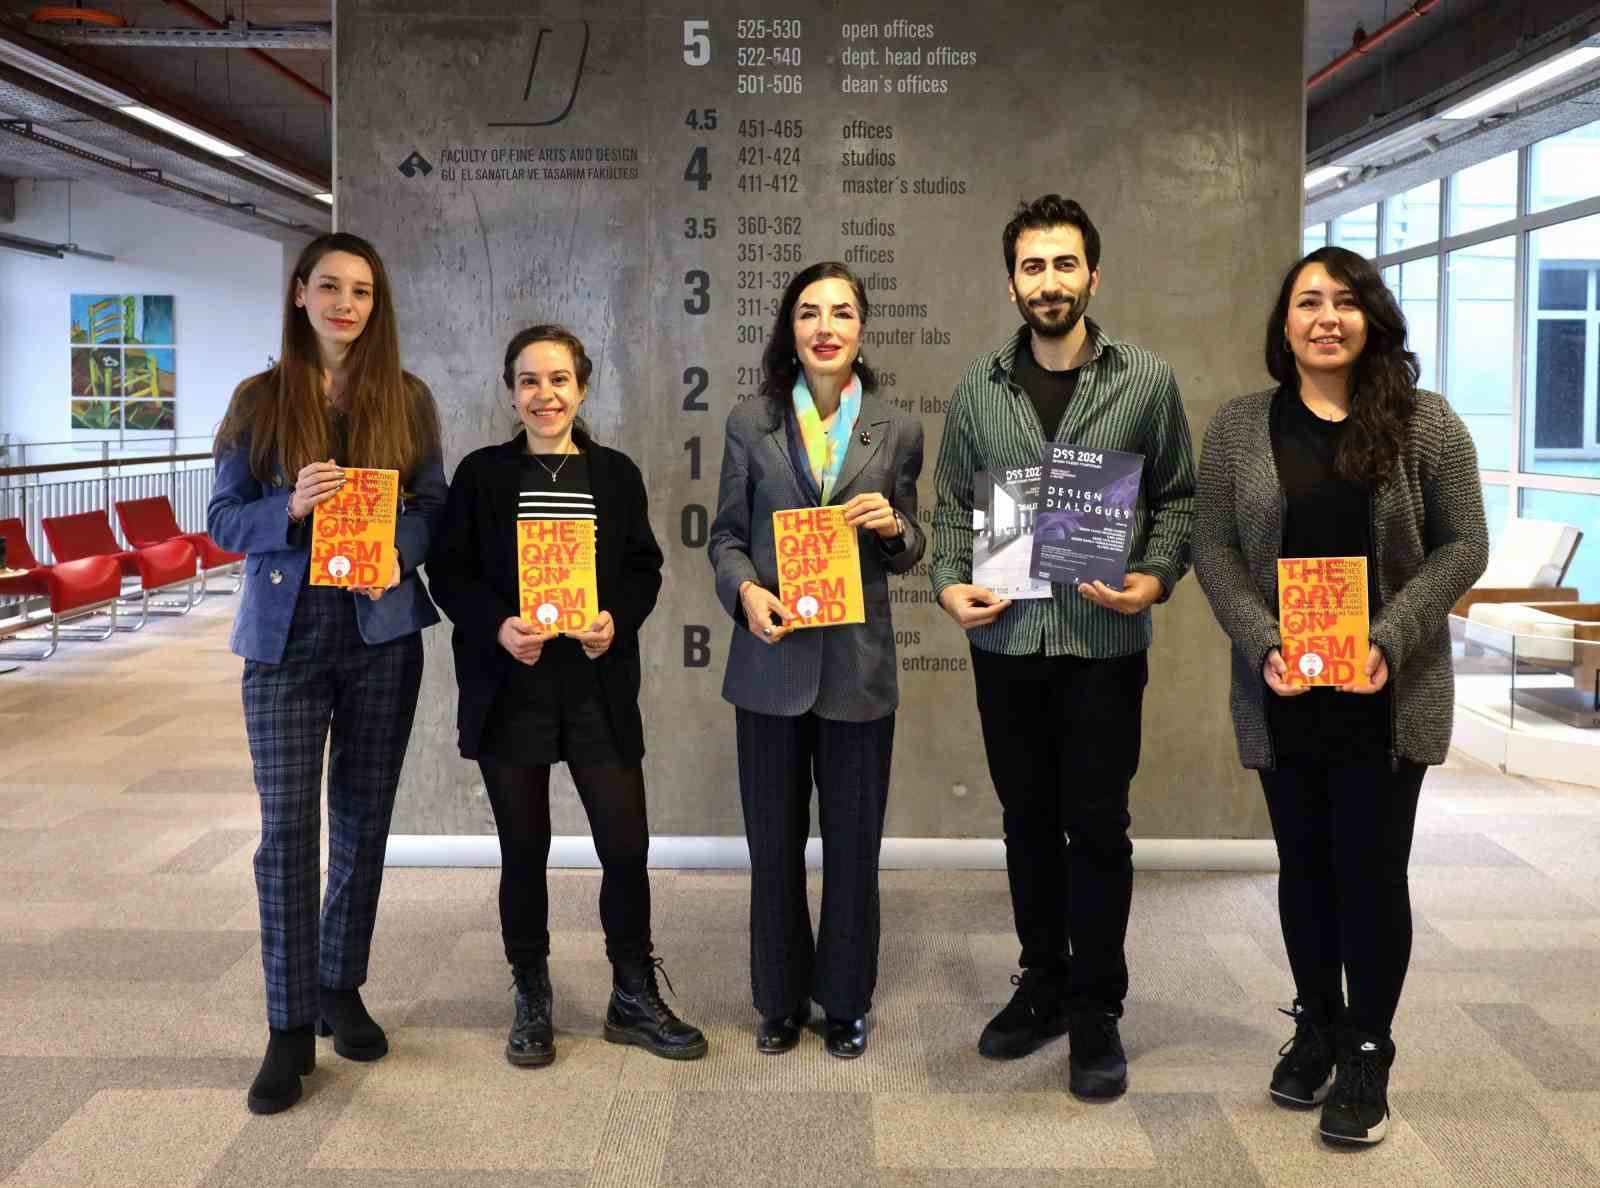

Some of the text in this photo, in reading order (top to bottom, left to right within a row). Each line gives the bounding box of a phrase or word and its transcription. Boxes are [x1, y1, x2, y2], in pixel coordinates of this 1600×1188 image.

[737, 20, 934, 41] 525-530 open offices
[683, 20, 711, 66] 5
[737, 47, 977, 69] 522-540 dept. head offices
[737, 75, 802, 94] 501-506
[897, 75, 948, 93] offices
[684, 108, 718, 130] 4.5
[738, 119, 893, 139] 451-465 offices
[491, 149, 507, 162] OF
[509, 149, 535, 162] FINE
[538, 149, 566, 162] ARTS
[569, 149, 593, 162] AND
[596, 149, 638, 162] DESIGN
[738, 147, 896, 167] 421-424 studios
[475, 167, 525, 181] SANATLAR
[527, 168, 541, 180] VE
[683, 146, 712, 191] 4
[738, 174, 798, 193] 411-412
[913, 176, 966, 194] studios
[684, 217, 717, 239] 3.5
[737, 217, 895, 236] 360-362 studios
[737, 244, 894, 263] 351-356 offices
[684, 269, 710, 315] 3
[737, 298, 779, 316] 311-3
[862, 328, 916, 348] mputer
[920, 327, 951, 345] labs
[682, 367, 709, 411] 2
[684, 436, 701, 480] 1
[1077, 451, 1104, 465] 2024
[1024, 466, 1043, 479] 202
[1047, 486, 1103, 502] DESIGN
[1046, 499, 1130, 520] DIALOGUES
[519, 520, 578, 543] THE
[681, 504, 708, 548] 0
[776, 509, 834, 533] THE
[1280, 560, 1345, 584] THE
[683, 624, 711, 668] B
[902, 656, 967, 671] entrance
